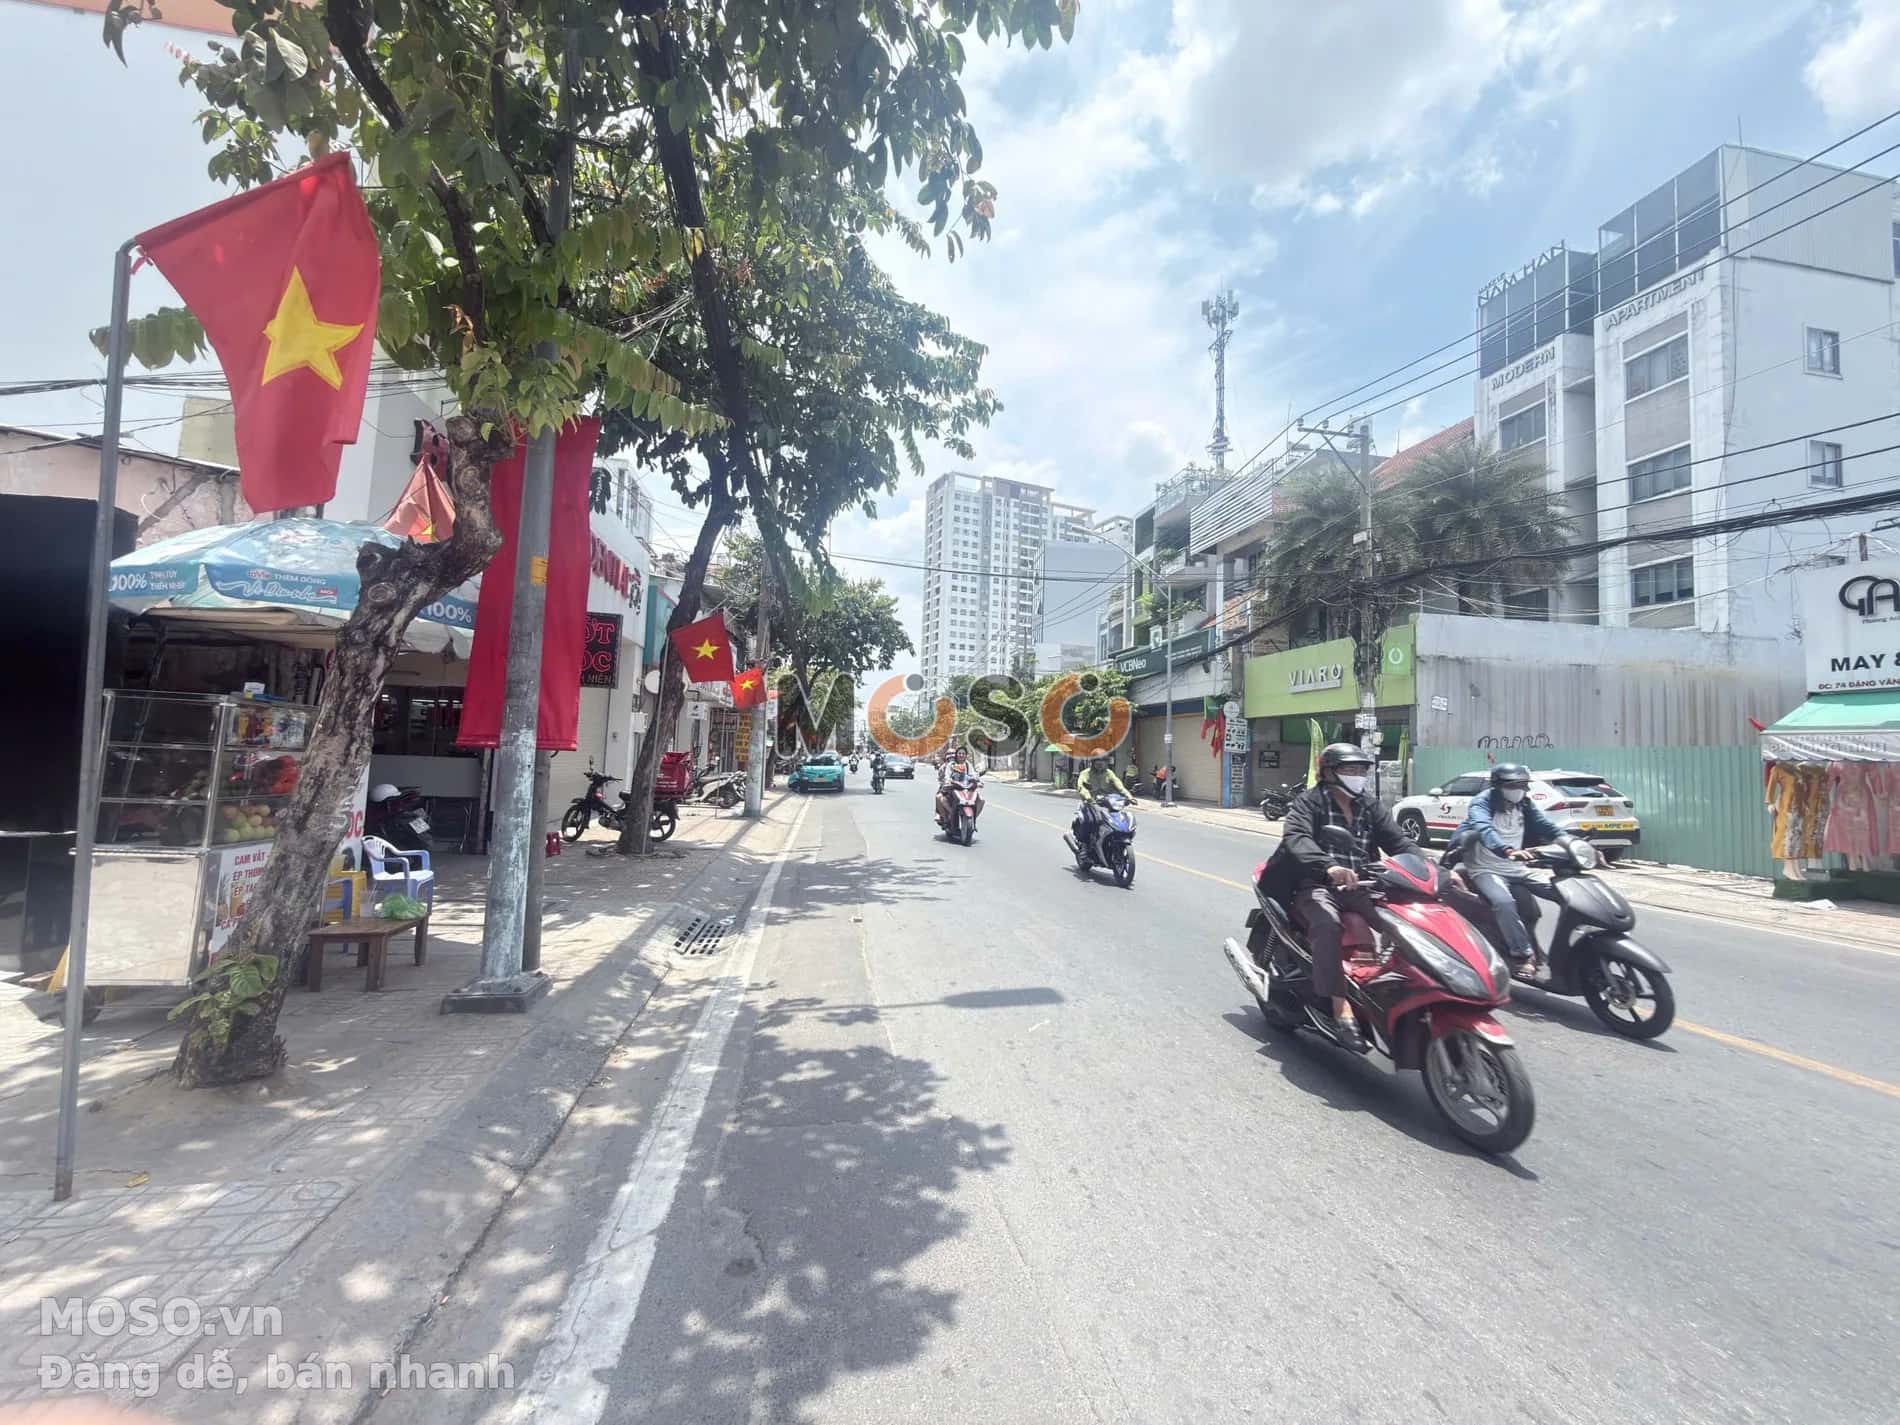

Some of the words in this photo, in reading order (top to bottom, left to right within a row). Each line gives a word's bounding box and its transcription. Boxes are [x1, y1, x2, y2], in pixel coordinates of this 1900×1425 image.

[1604, 269, 1705, 332] APARTMENT
[1490, 346, 1556, 391] MODERN
[420, 601, 472, 623] 100%
[1120, 658, 1147, 673] VCBNeo
[1830, 653, 1886, 673] MAY
[1288, 663, 1343, 686] VIARO
[234, 854, 251, 866] CAM
